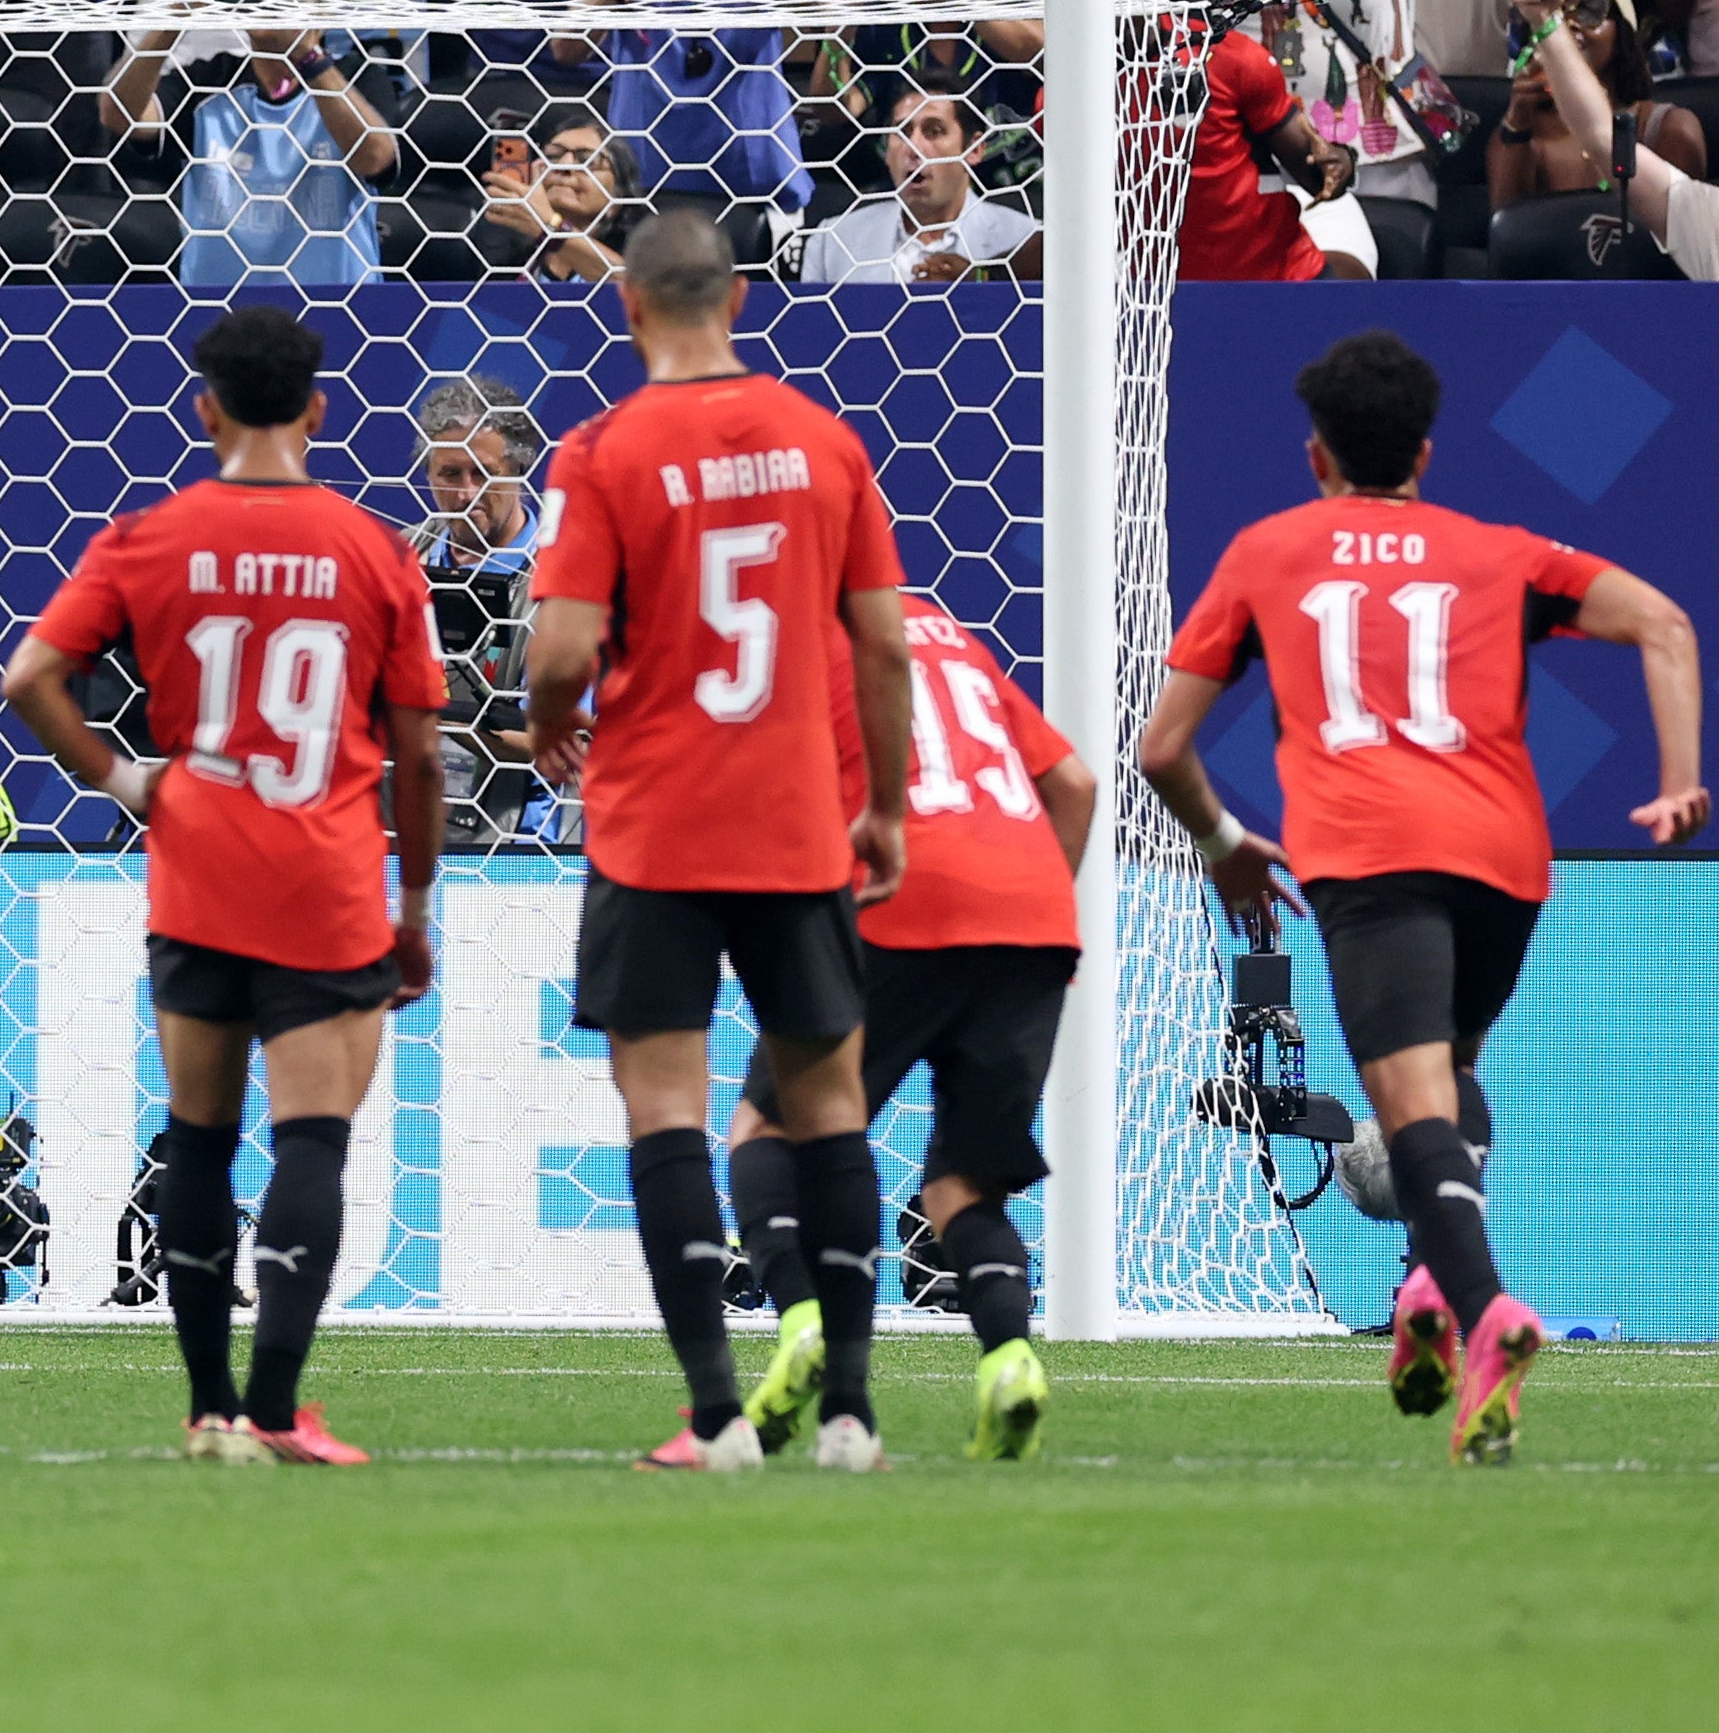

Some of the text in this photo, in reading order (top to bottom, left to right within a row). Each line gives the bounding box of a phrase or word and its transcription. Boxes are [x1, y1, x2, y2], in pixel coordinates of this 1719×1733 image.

[659, 463, 695, 508] R.
[1331, 530, 1426, 566] ZICO
[188, 551, 338, 599] M. ATTIA
[694, 521, 787, 724] 5
[184, 615, 351, 809] 19
[907, 658, 1043, 823] 15
[1297, 580, 1468, 755] 11
